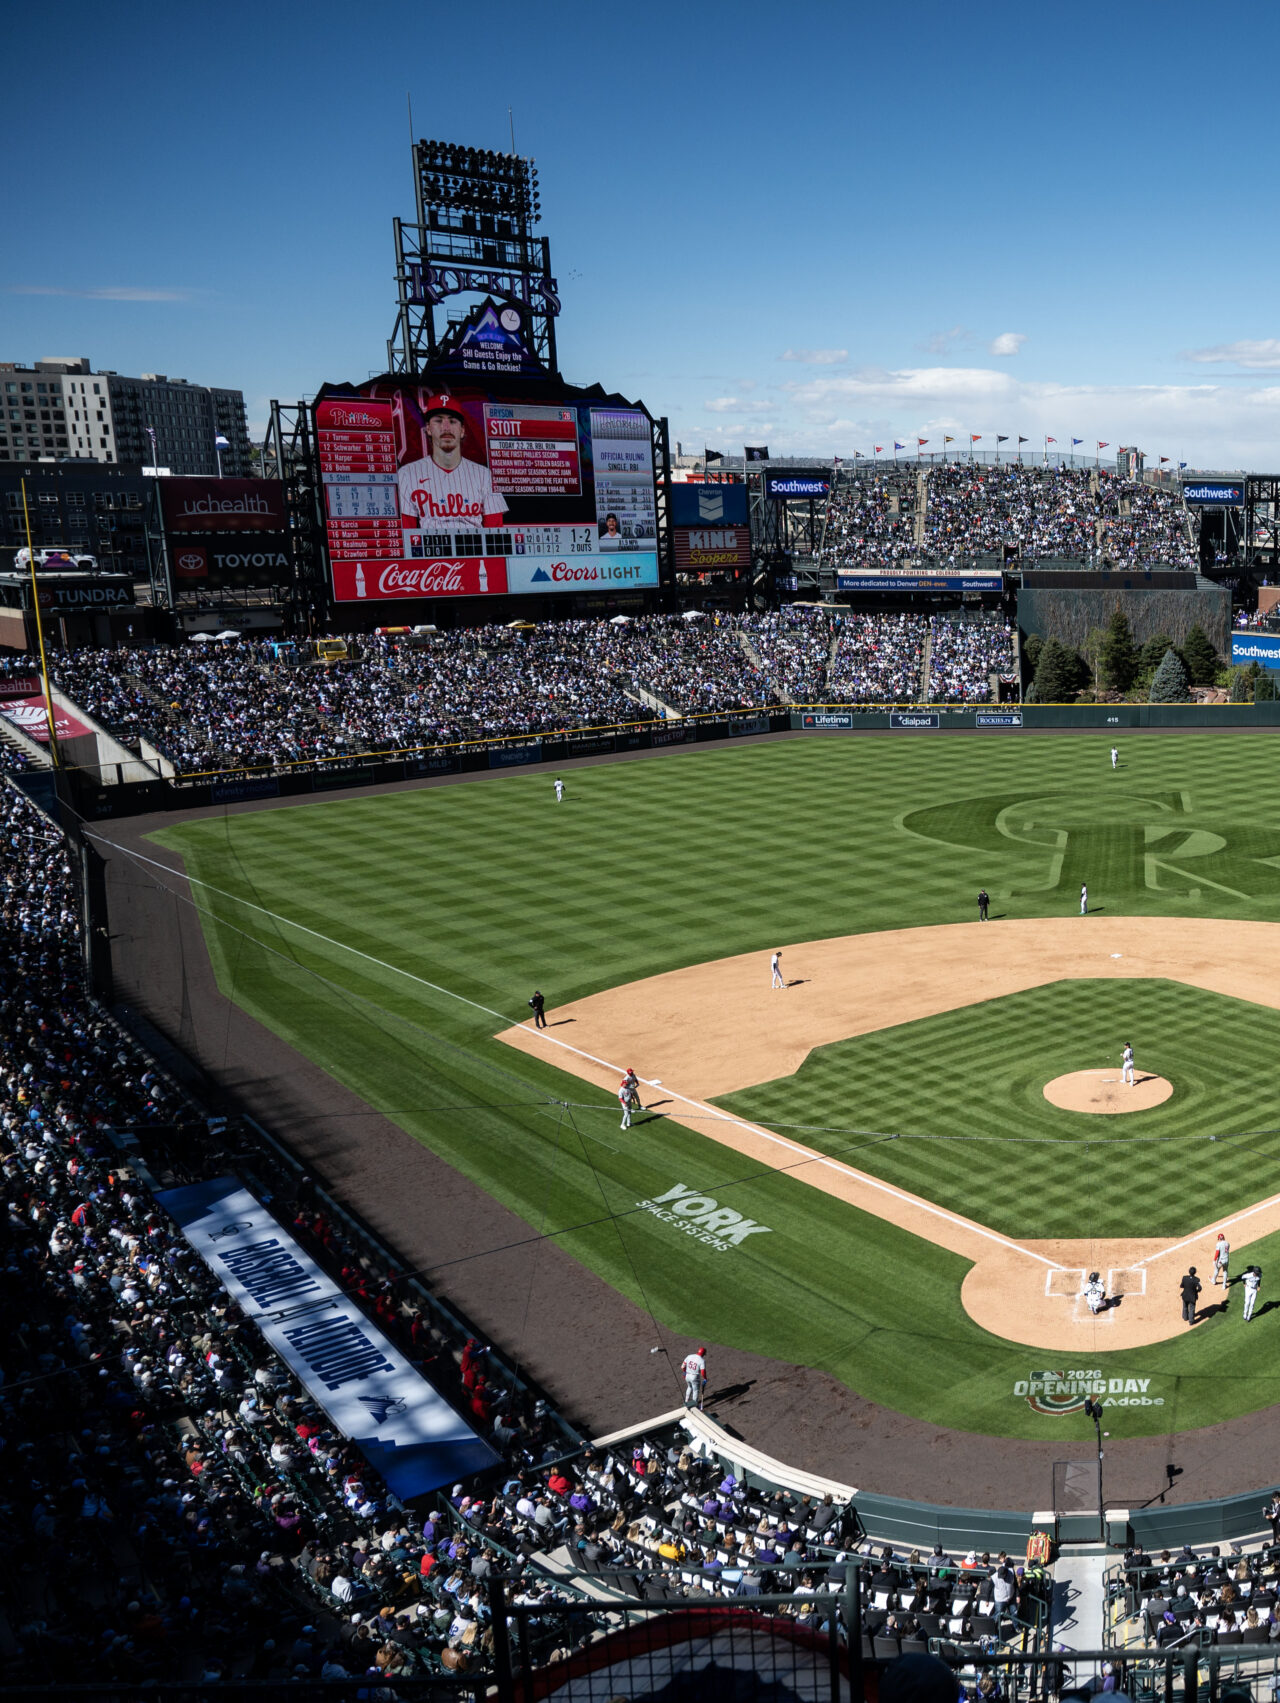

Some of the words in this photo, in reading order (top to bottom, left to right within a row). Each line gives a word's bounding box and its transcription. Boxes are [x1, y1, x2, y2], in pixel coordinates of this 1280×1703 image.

[407, 262, 562, 317] ROCKIES
[480, 341, 504, 350] WELCOME
[474, 350, 494, 359] Guests
[495, 351, 511, 361] Enjoy
[512, 352, 522, 361] the
[463, 360, 480, 370] Game
[481, 362, 487, 370] &
[488, 362, 496, 370] Go
[497, 362, 521, 372] Rockies!
[440, 395, 449, 406] P
[330, 408, 382, 427] Phillies
[489, 408, 514, 417] BRYSON
[491, 420, 521, 436] STOTT
[499, 441, 514, 449] TODAY
[601, 452, 623, 460] OFFICIAL
[625, 453, 644, 461] RULING
[771, 480, 823, 493] Southwest
[1183, 486, 1233, 500] Southwest
[184, 494, 269, 513] uchealth
[688, 531, 737, 549] KING
[577, 543, 592, 552] OUTS
[213, 552, 289, 569] TOYOTA
[690, 549, 739, 567] Soopers
[378, 562, 465, 594] Coca-Cola
[551, 562, 599, 583] Coors
[600, 566, 641, 581] LIGHT
[962, 580, 993, 588] Southwest
[55, 588, 129, 604] TUNDRA
[6, 700, 29, 709] THE
[815, 715, 849, 724] Lifetime
[901, 717, 931, 727] dialpad
[652, 1183, 773, 1245] YORK
[673, 1218, 733, 1251] SYSTEMS
[217, 1238, 321, 1309] BASEBALL
[282, 1314, 396, 1391] ALTITUDE
[1067, 1370, 1102, 1379] 2026
[1013, 1379, 1106, 1396] OPENING
[1109, 1378, 1151, 1393] DAY
[1102, 1397, 1165, 1407] Adobe
